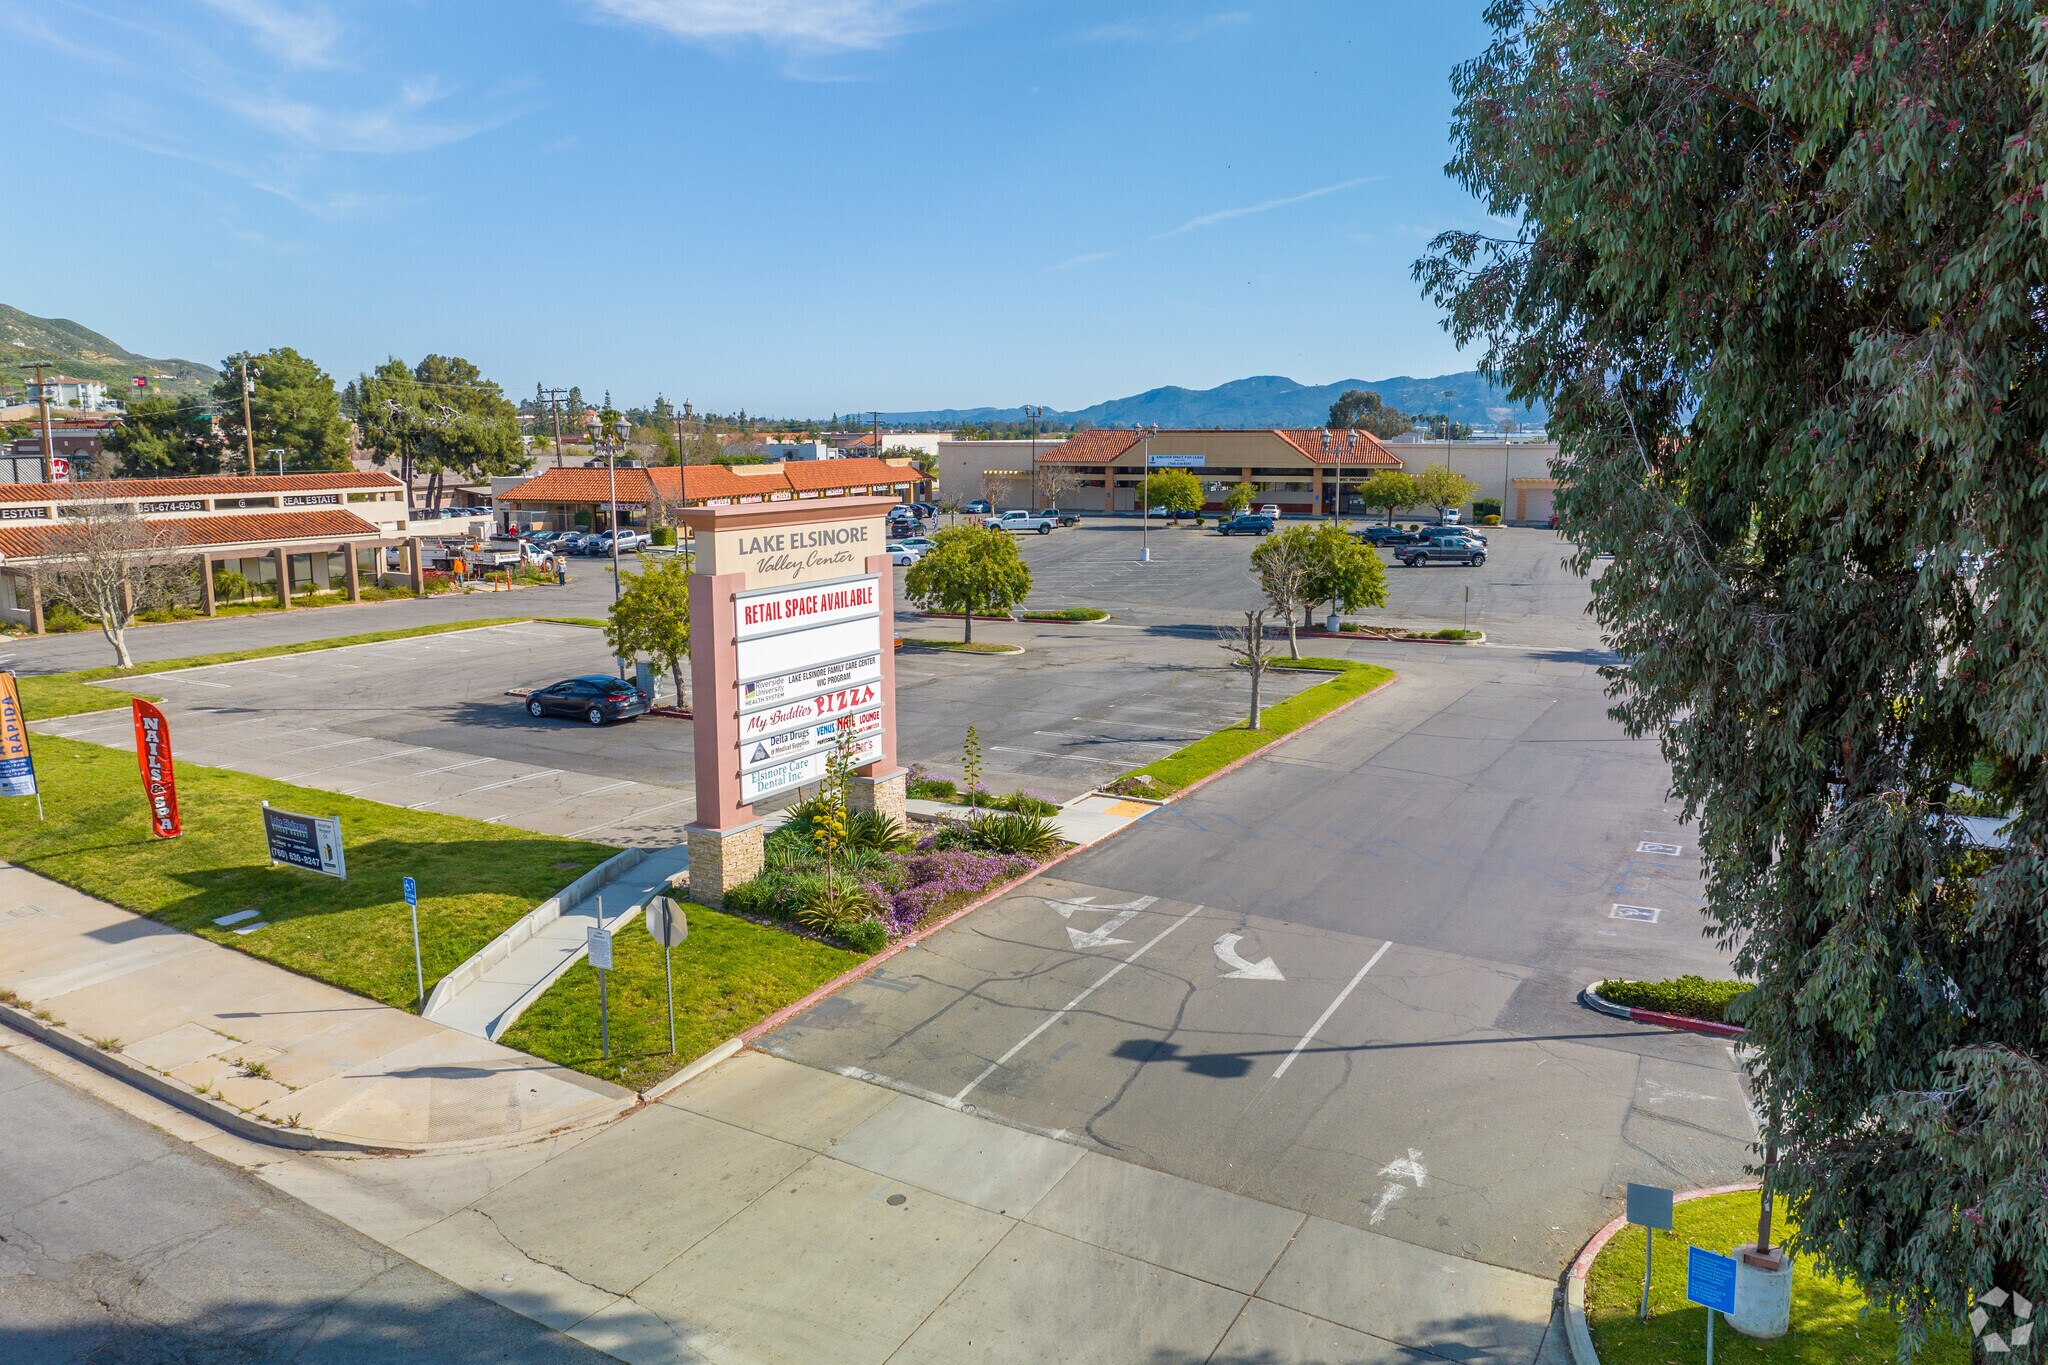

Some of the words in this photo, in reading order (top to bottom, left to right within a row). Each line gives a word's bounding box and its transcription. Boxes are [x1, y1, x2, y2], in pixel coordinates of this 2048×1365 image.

[283, 496, 304, 506] REAL
[306, 495, 337, 505] ESTATE
[2, 508, 44, 519] ESTATE
[738, 534, 786, 556] LAKE
[790, 526, 868, 550] ELSINORE
[756, 554, 805, 579] Valley
[806, 550, 855, 568] Center
[744, 601, 782, 625] RETAIL
[785, 595, 818, 618] SPACE
[820, 586, 872, 612] AVAILABLE
[788, 674, 802, 684] LAKE
[802, 668, 827, 681] ELSINORE
[828, 664, 844, 676] FAMILY
[844, 660, 858, 671] CARE
[858, 656, 876, 668] CENTER
[816, 678, 826, 687] WIC
[828, 672, 851, 684] PROGRAM
[756, 678, 784, 690] Riverside
[756, 685, 784, 697] University
[745, 697, 764, 706] HEALTH
[765, 692, 784, 702] SYSTEM
[747, 716, 768, 732] My
[770, 705, 812, 726] Buddies
[814, 685, 875, 716] PIZZA
[2, 695, 22, 754] RÁPIDA
[816, 723, 835, 736] VENUS
[860, 710, 880, 724] LOUNGE
[770, 734, 788, 746] Delta
[790, 729, 810, 740] Drugs
[775, 744, 792, 754] Medical
[792, 740, 810, 749] Supplies
[142, 717, 162, 782] NAILS
[838, 738, 873, 757] mther's
[752, 766, 787, 784] Elsinore
[789, 760, 808, 772] Care
[151, 784, 166, 794] &
[758, 774, 786, 792] Dental
[788, 772, 804, 782] Inc.
[154, 796, 172, 830] SPA
[272, 847, 288, 860] (760)
[288, 852, 320, 866] 630-8247
